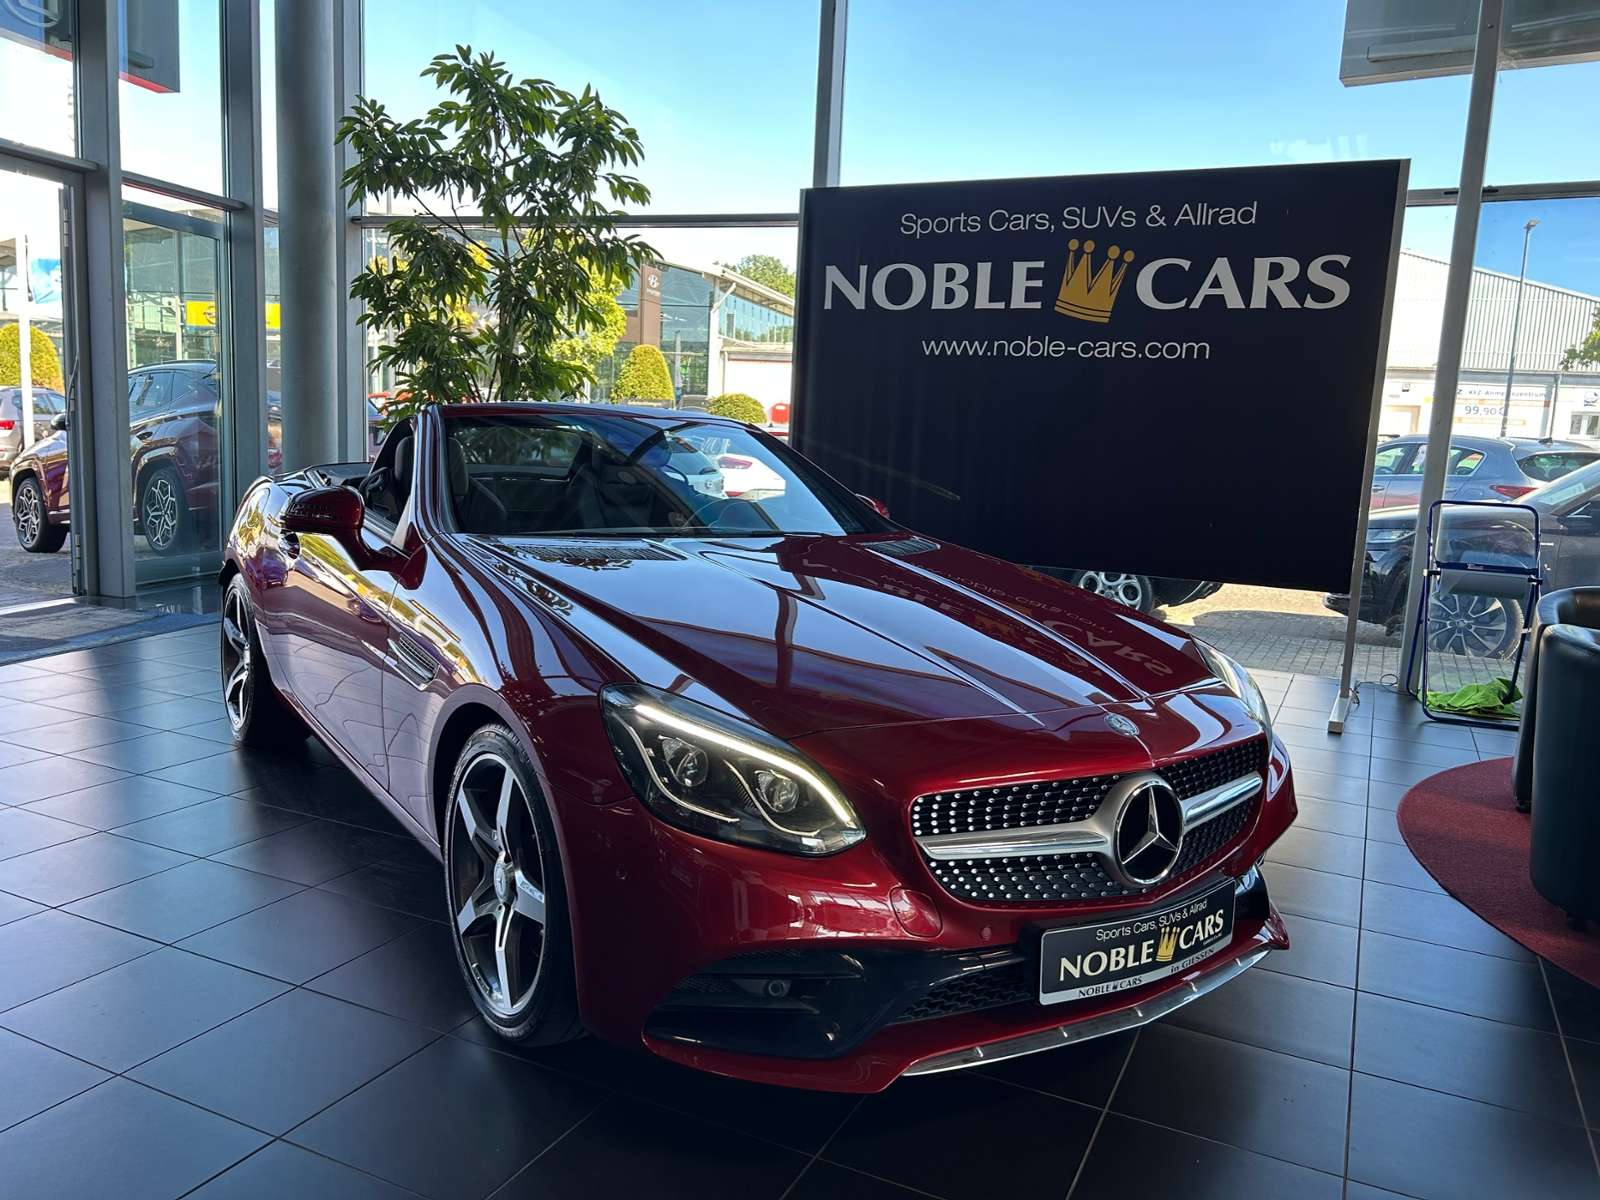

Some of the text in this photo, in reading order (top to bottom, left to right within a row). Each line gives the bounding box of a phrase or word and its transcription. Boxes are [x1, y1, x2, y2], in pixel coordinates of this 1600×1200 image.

[901, 201, 1257, 238] Sports Cars, SUVs & Allrad
[824, 255, 1350, 310] NOBLE CARS
[922, 336, 1209, 359] www.noble-cars.com
[1096, 926, 1131, 941] Sports
[1159, 911, 1181, 927] SUVs
[1182, 908, 1188, 919] &
[1189, 899, 1208, 916] Allrad
[1059, 909, 1224, 981] NOBLE CARS
[1078, 984, 1110, 997] NOBLE
[1120, 977, 1142, 989] CARS
